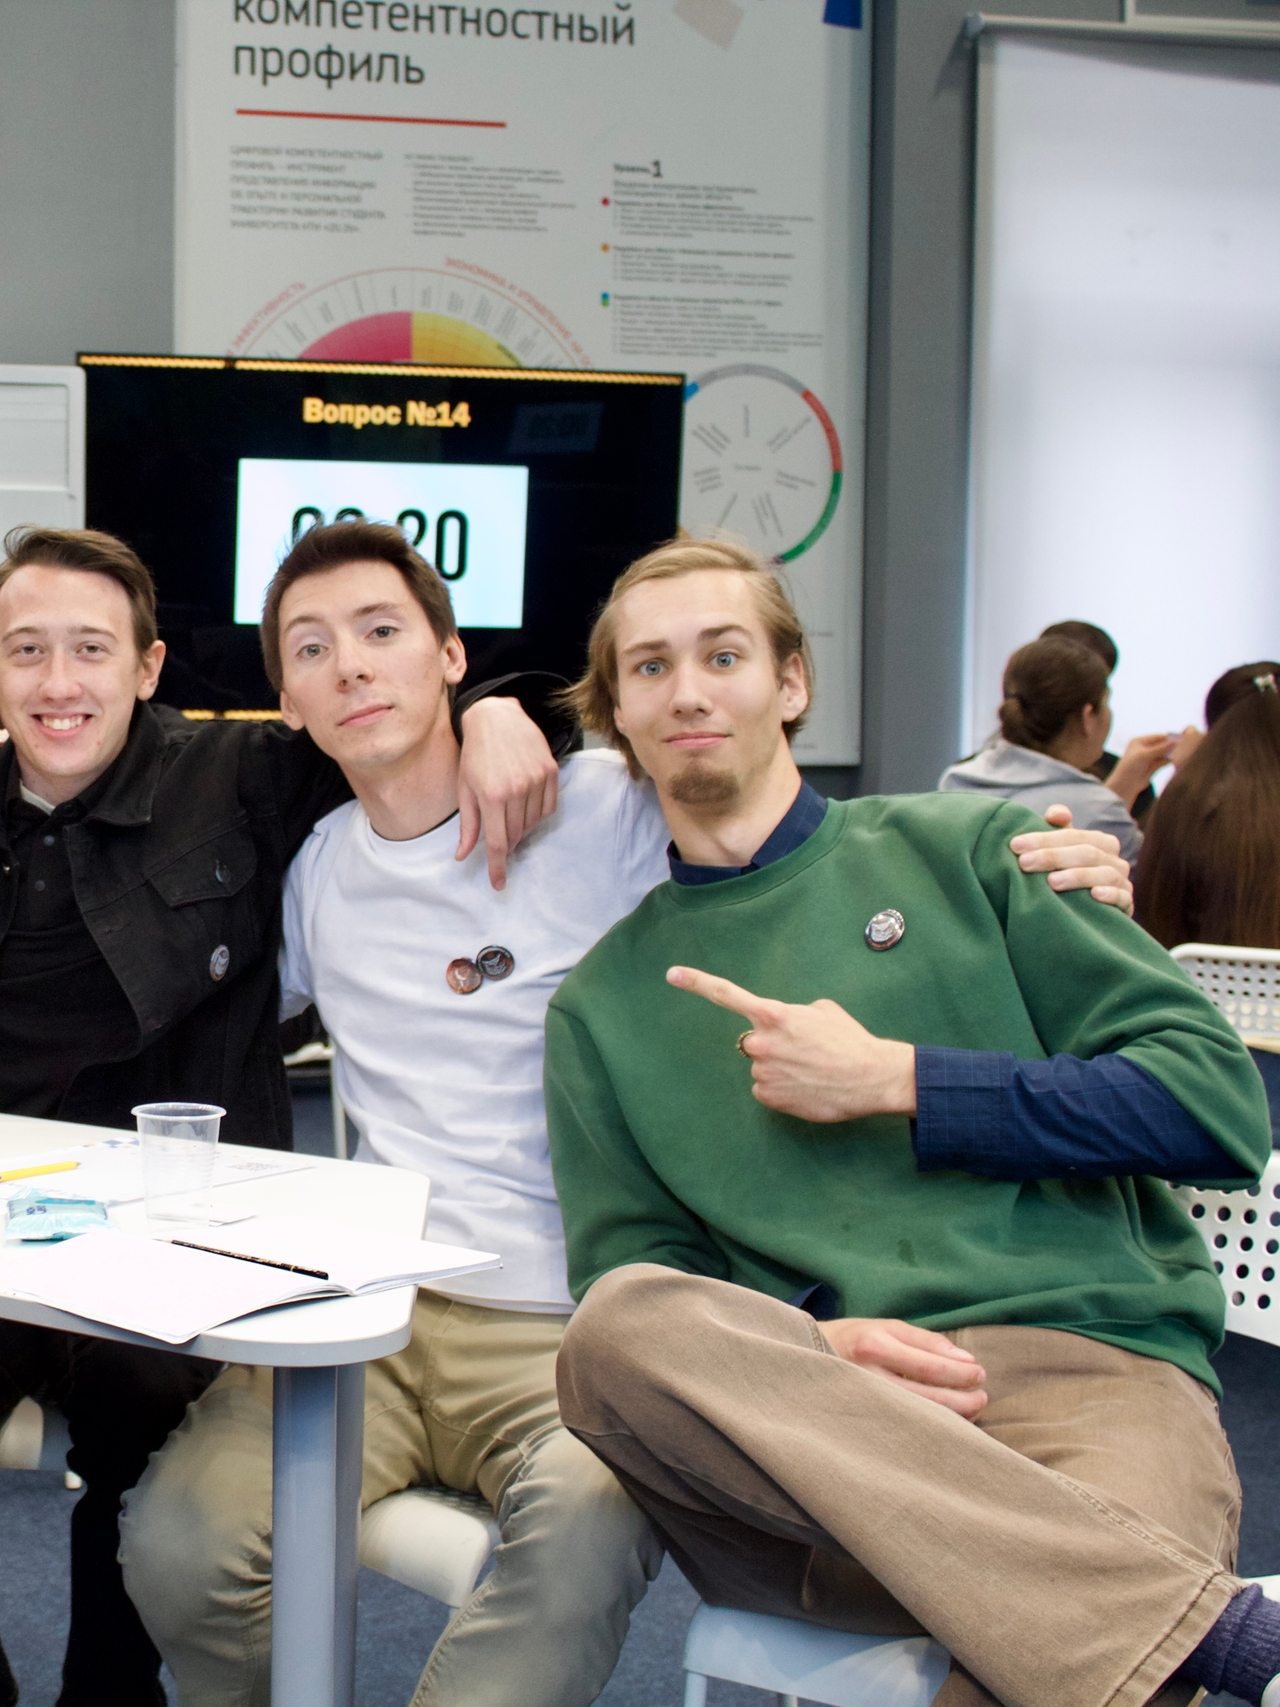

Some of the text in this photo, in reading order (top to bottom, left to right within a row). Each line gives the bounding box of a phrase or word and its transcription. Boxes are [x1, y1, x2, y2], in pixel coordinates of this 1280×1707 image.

[233, 0, 635, 46] компетентностный
[233, 43, 425, 90] профиль
[303, 397, 472, 429] Вопрос №14
